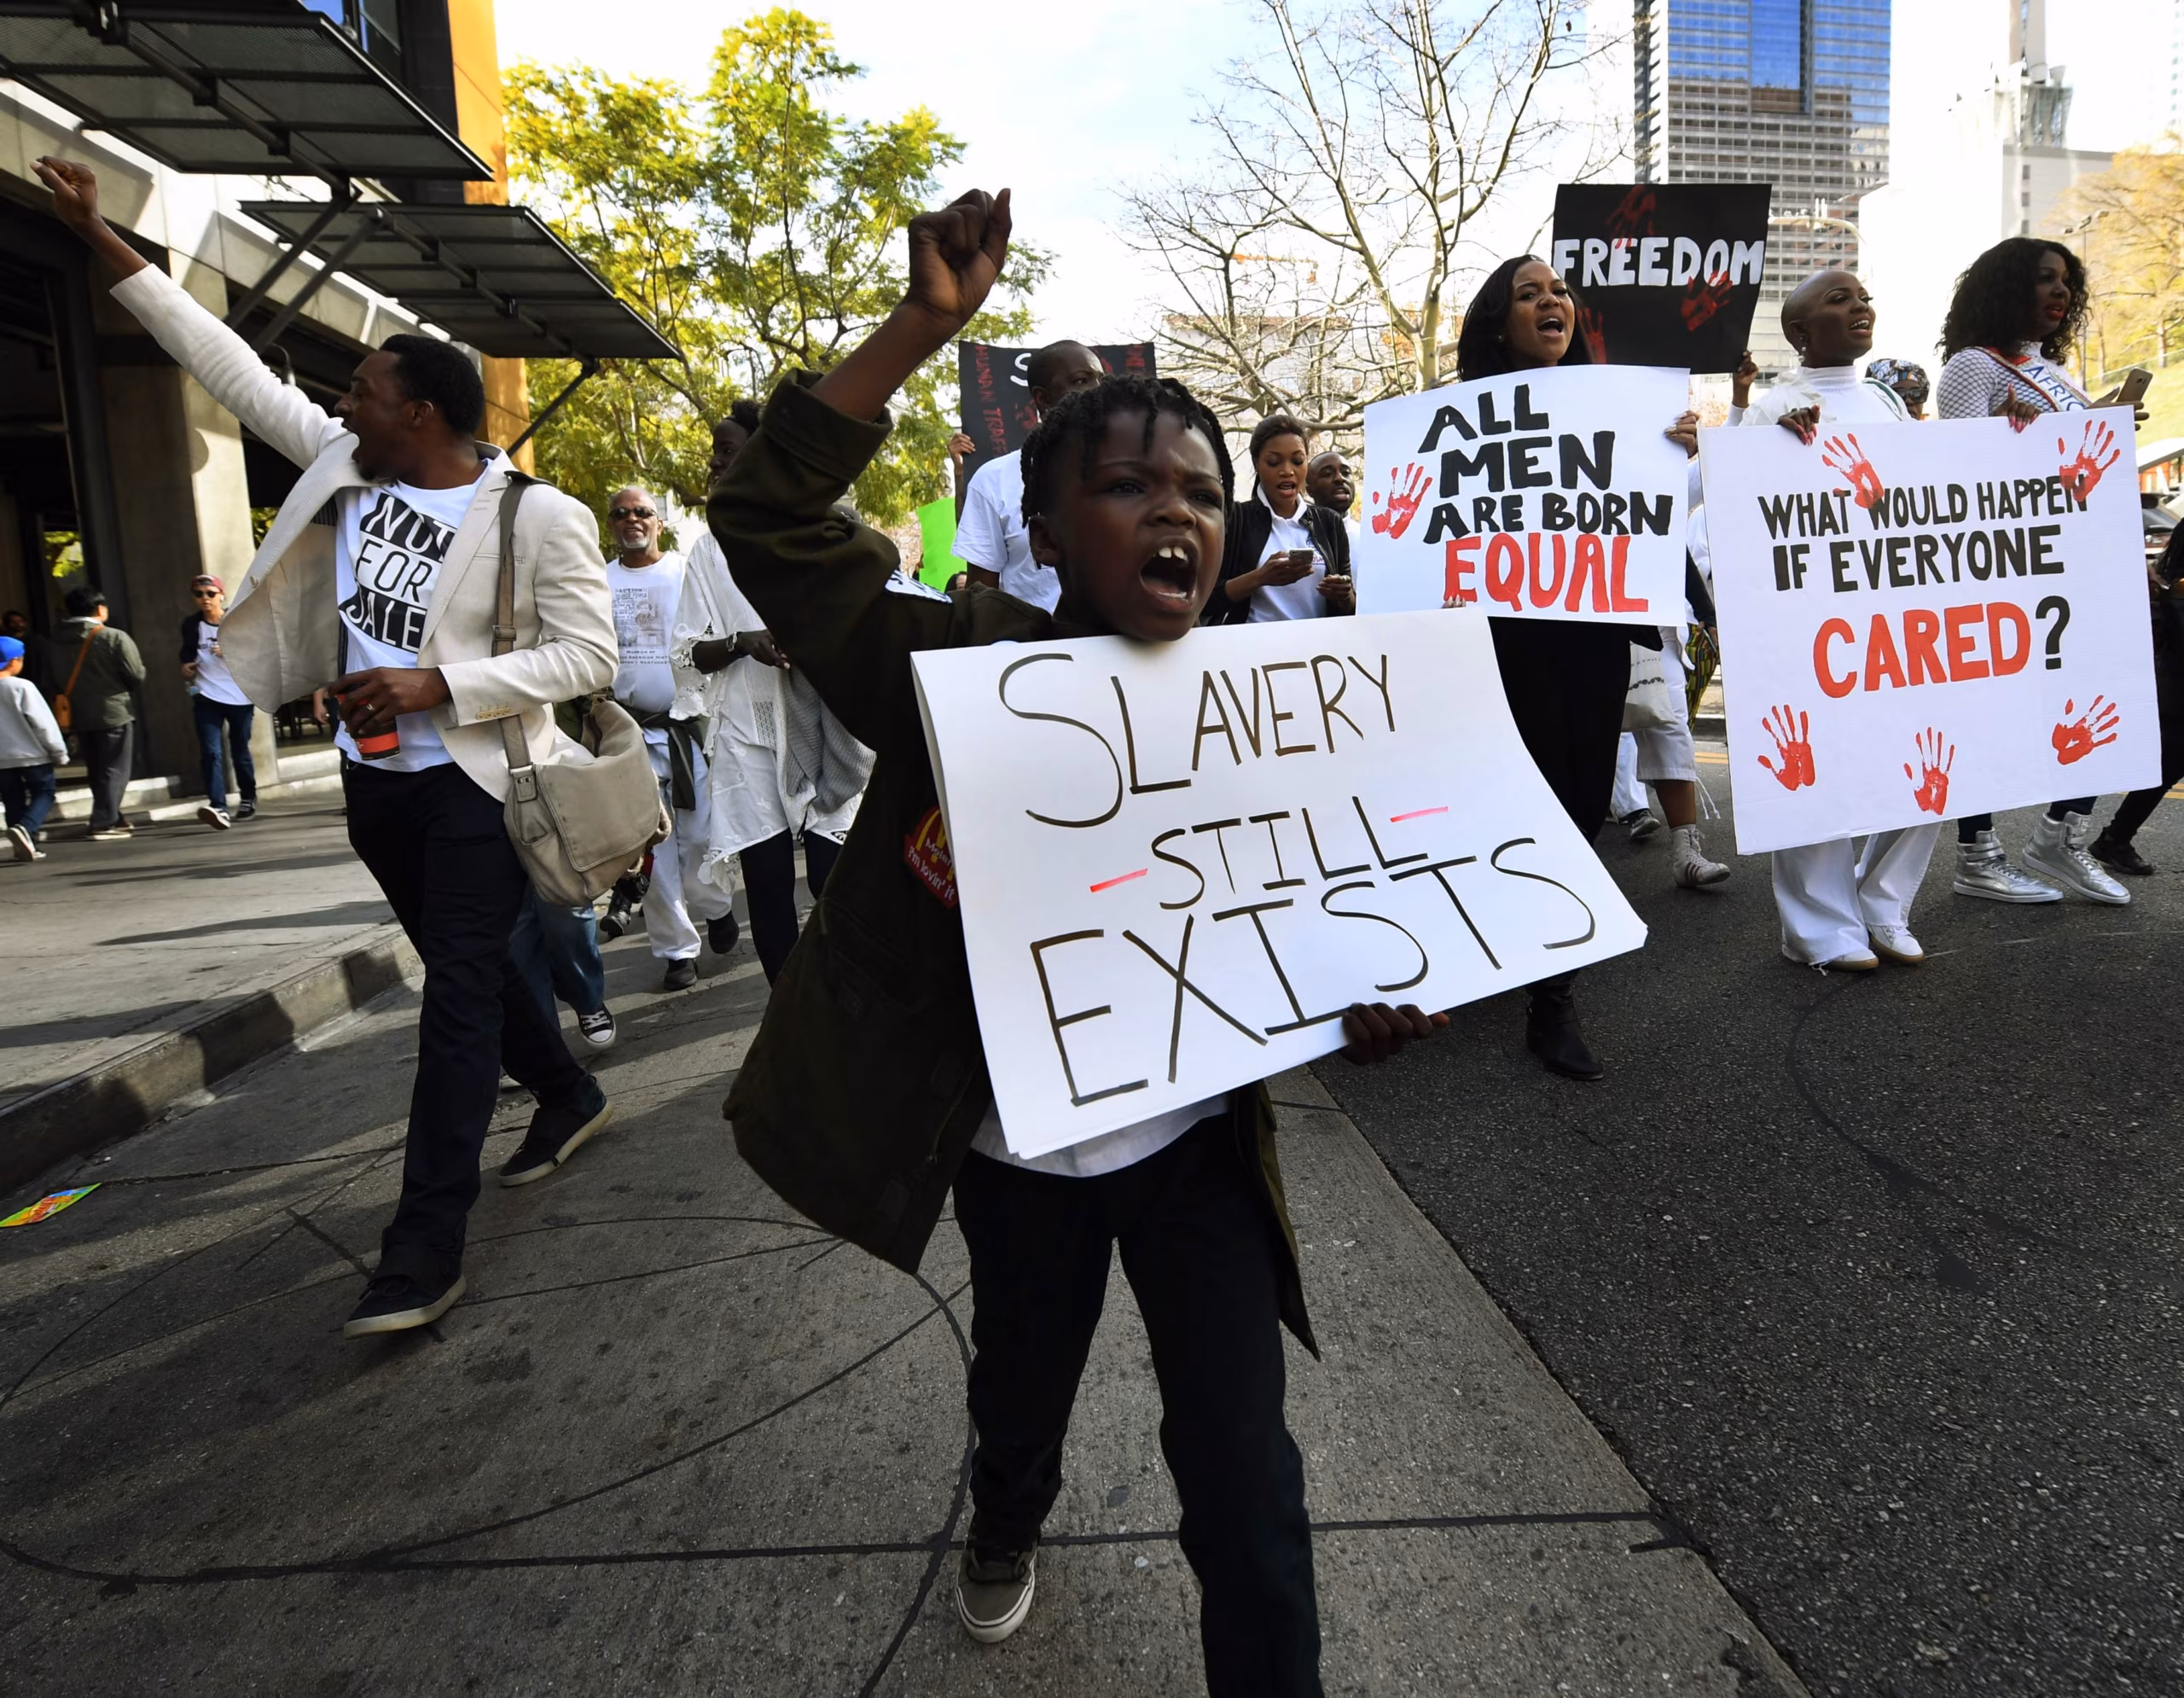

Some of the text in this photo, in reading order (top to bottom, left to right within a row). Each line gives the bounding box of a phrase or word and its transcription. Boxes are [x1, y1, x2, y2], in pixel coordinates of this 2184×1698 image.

[1553, 237, 1765, 287] FREEDOM
[1418, 383, 1549, 454] ALL
[2021, 365, 2087, 411] AFRIC
[1438, 430, 1615, 498] MEN
[364, 495, 458, 562] NOT
[1422, 491, 1673, 544] ARE BORN
[1757, 474, 2088, 539] WHAT WOULD HAPPEN
[355, 538, 433, 603] FOR
[1443, 532, 1648, 612] EQUAL
[1772, 524, 2065, 593] IF EVERYONE
[346, 589, 427, 652] SALE
[1814, 595, 2071, 698] CARED?
[998, 652, 1396, 829] SLAVERY
[1030, 837, 1596, 1108] EXISTS
